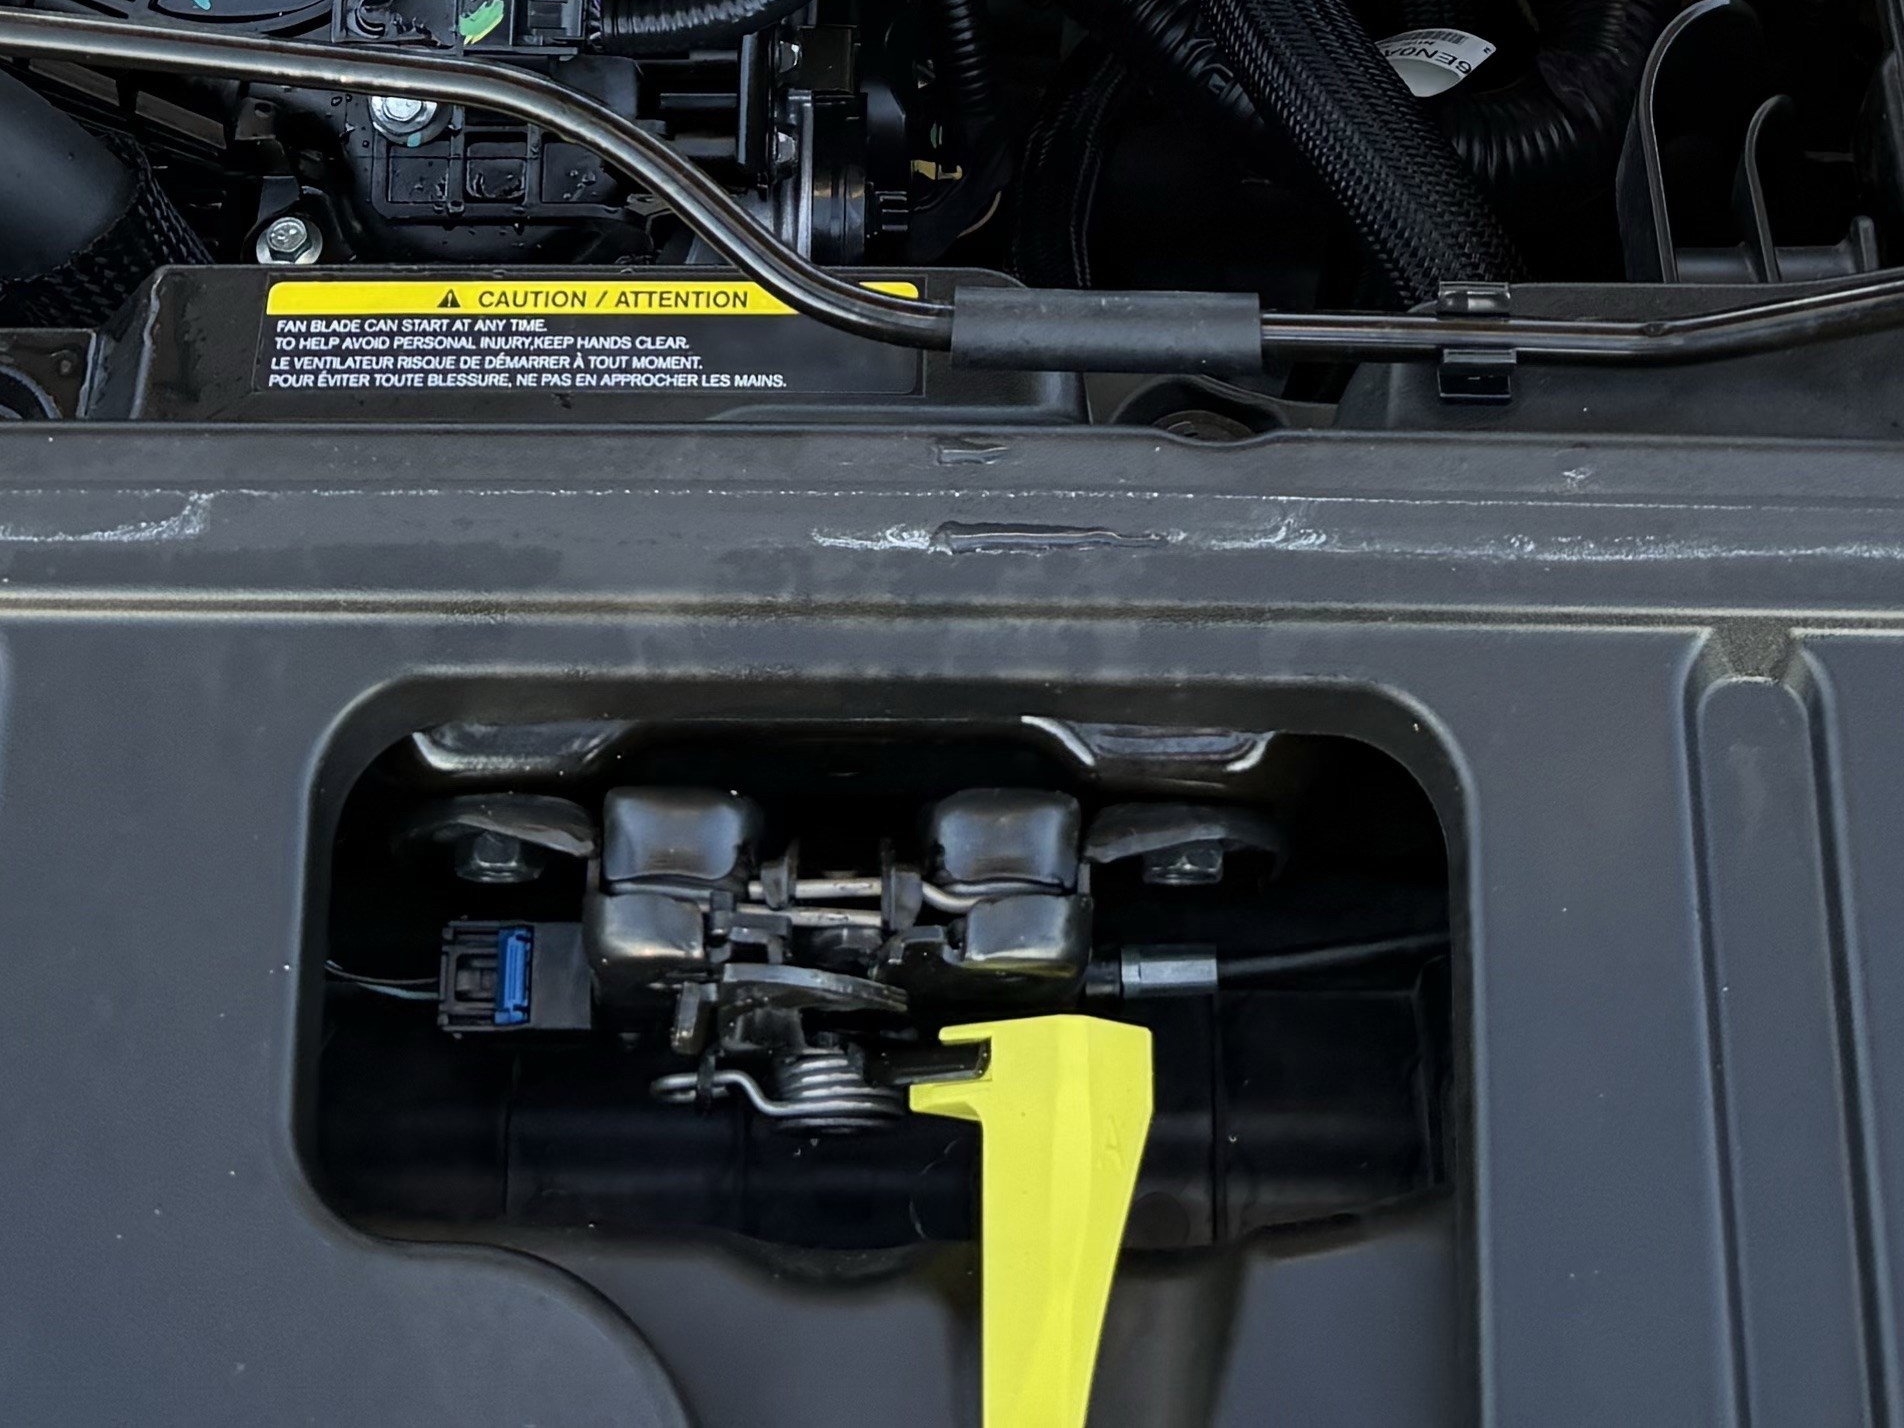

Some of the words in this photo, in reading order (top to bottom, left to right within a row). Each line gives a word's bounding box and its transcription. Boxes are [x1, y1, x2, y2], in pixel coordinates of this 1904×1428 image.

[478, 290, 587, 308] CAUTION
[615, 290, 749, 309] ATTENTION
[276, 319, 307, 332] FAN
[310, 319, 361, 332] BLADE
[364, 319, 398, 332] CAN
[401, 319, 449, 332] START
[451, 319, 472, 332] AT
[474, 319, 507, 332] ANY
[510, 319, 547, 332] TIME.
[275, 336, 296, 350] TO
[299, 336, 341, 350] HELP
[342, 336, 391, 350] AVOID
[393, 336, 477, 350] PERSONAL
[577, 336, 632, 350] HANDS
[635, 336, 690, 350] CLEAR.
[271, 356, 290, 369] LE
[294, 356, 394, 369] VENTILATEUR
[397, 356, 455, 369] RISQUE
[460, 356, 481, 369] DE
[484, 352, 571, 369] DÉMARRER
[573, 352, 585, 369] À
[588, 356, 630, 369] TOUT
[632, 356, 703, 369] MOMENT.
[269, 374, 315, 387] POUR
[317, 371, 371, 387] ÉVITER
[373, 374, 425, 387] TOUTE
[427, 374, 512, 387] BLESSURE,
[516, 374, 538, 387] NE
[540, 374, 572, 387] PAS
[575, 374, 597, 387] EN
[599, 374, 698, 387] APPROCHER
[701, 374, 731, 387] LES
[733, 374, 787, 387] MAINS.
